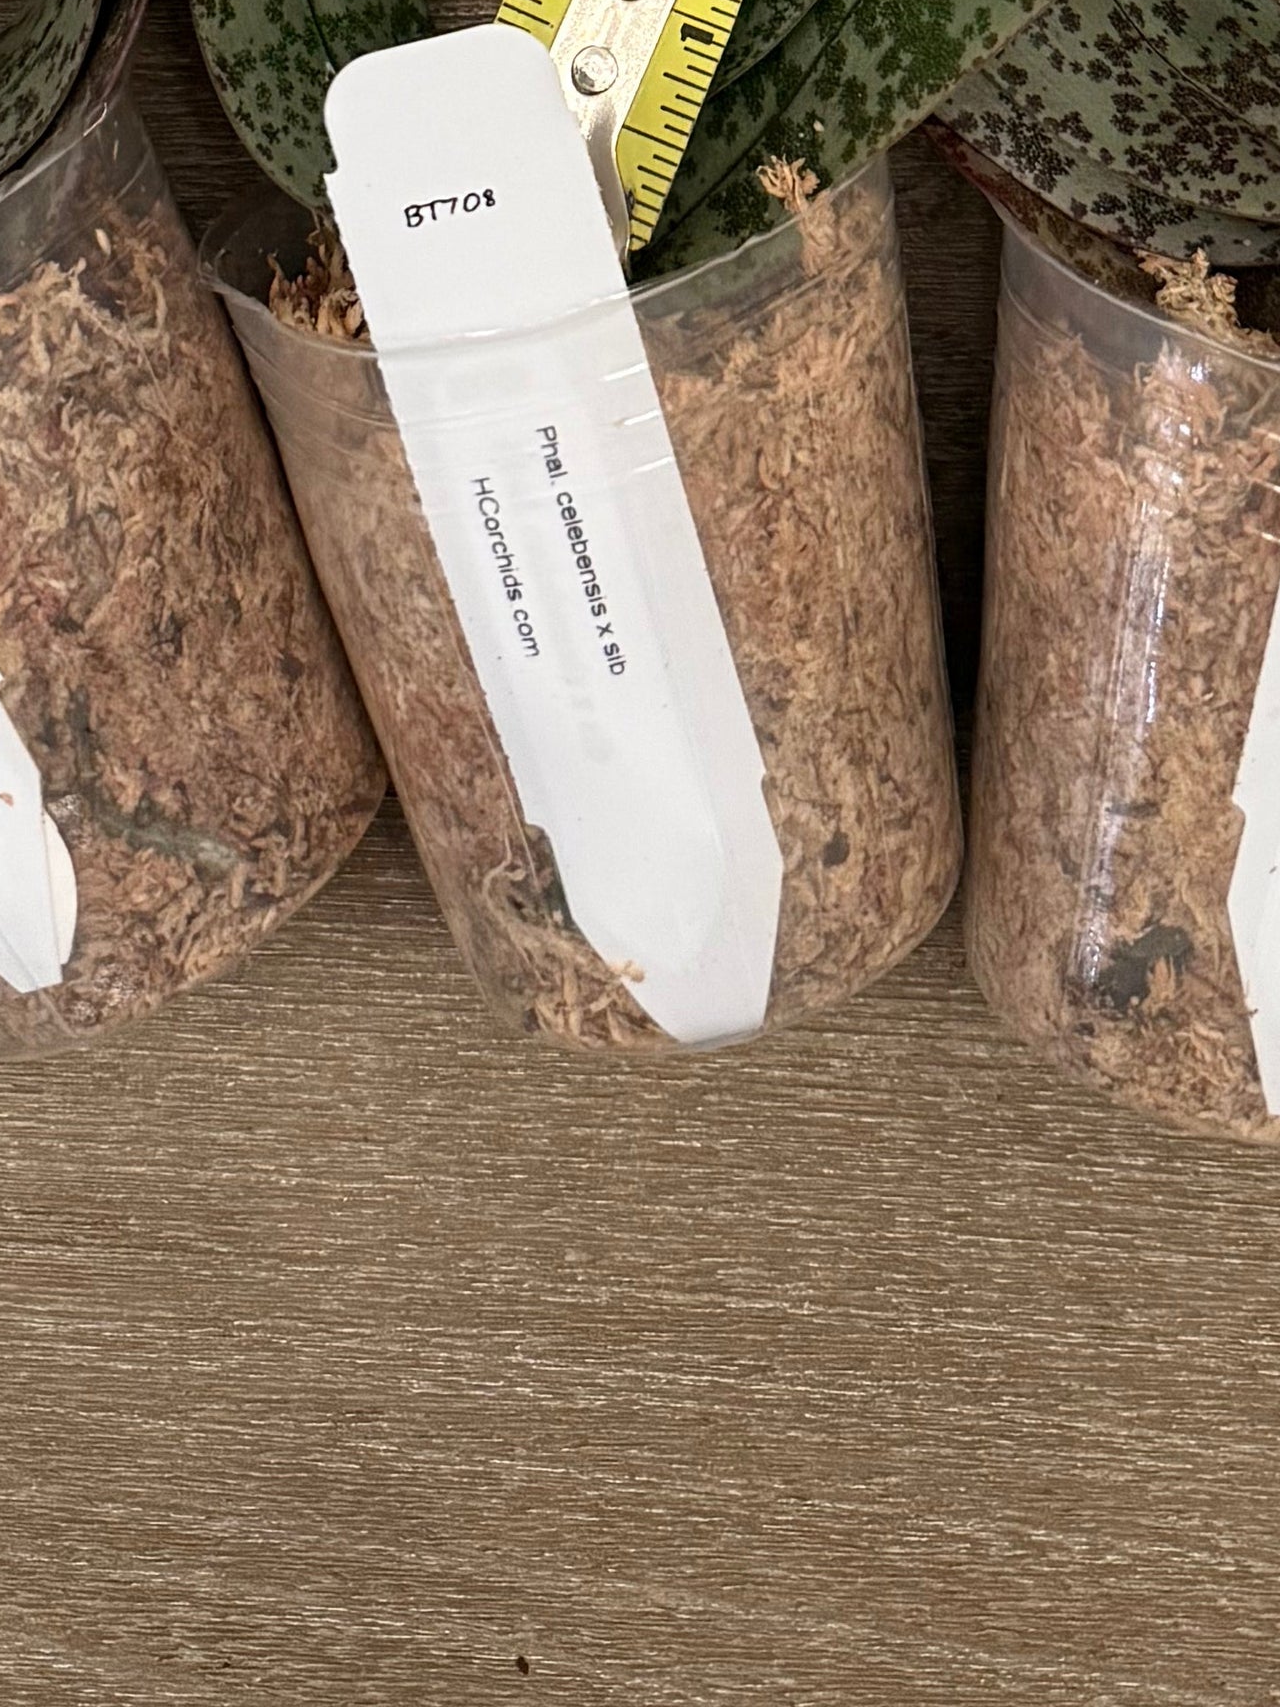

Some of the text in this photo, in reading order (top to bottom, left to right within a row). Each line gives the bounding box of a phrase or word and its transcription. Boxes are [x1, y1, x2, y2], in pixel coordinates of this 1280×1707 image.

[680, 22, 715, 46] 1
[403, 188, 496, 228] BT708
[556, 491, 608, 617] celebensis
[604, 642, 626, 677] sib
